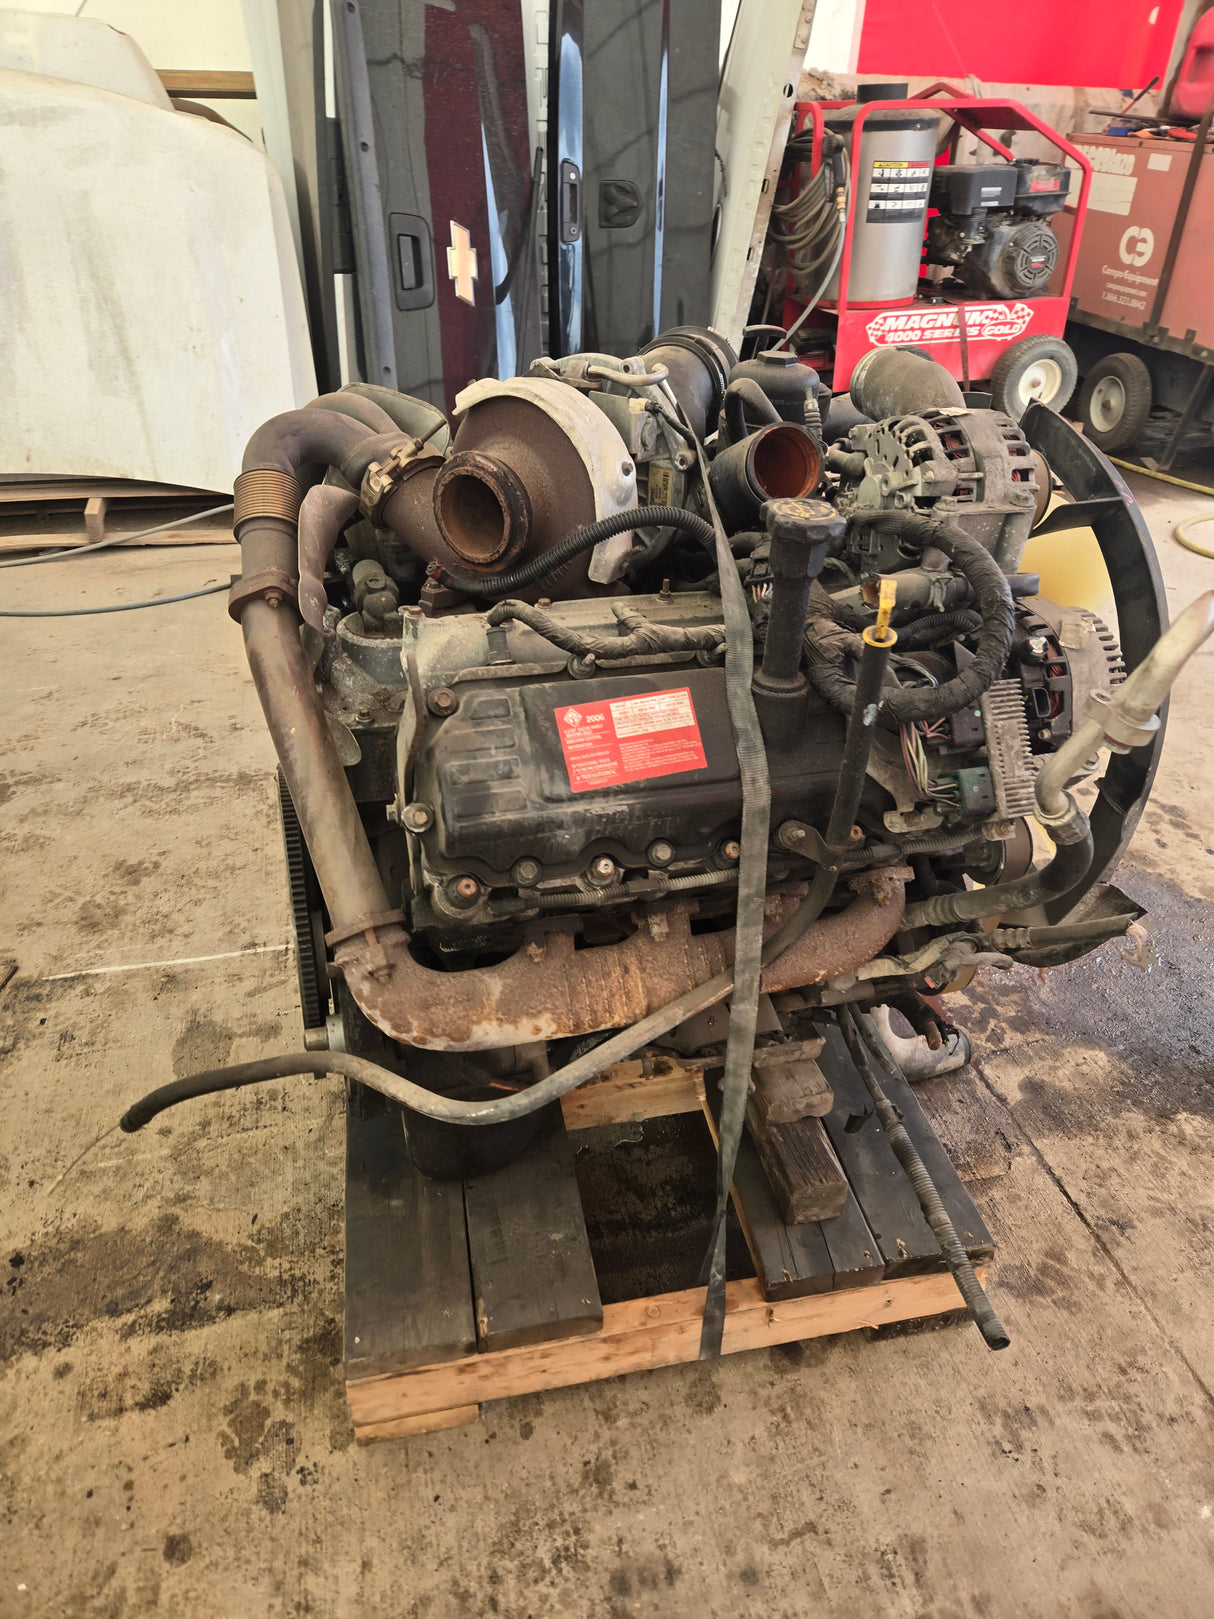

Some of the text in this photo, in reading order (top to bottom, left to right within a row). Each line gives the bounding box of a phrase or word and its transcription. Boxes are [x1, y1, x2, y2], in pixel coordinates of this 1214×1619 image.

[885, 310, 993, 330] MAGNUM
[885, 324, 1021, 342] 4000 SERIS GOLD
